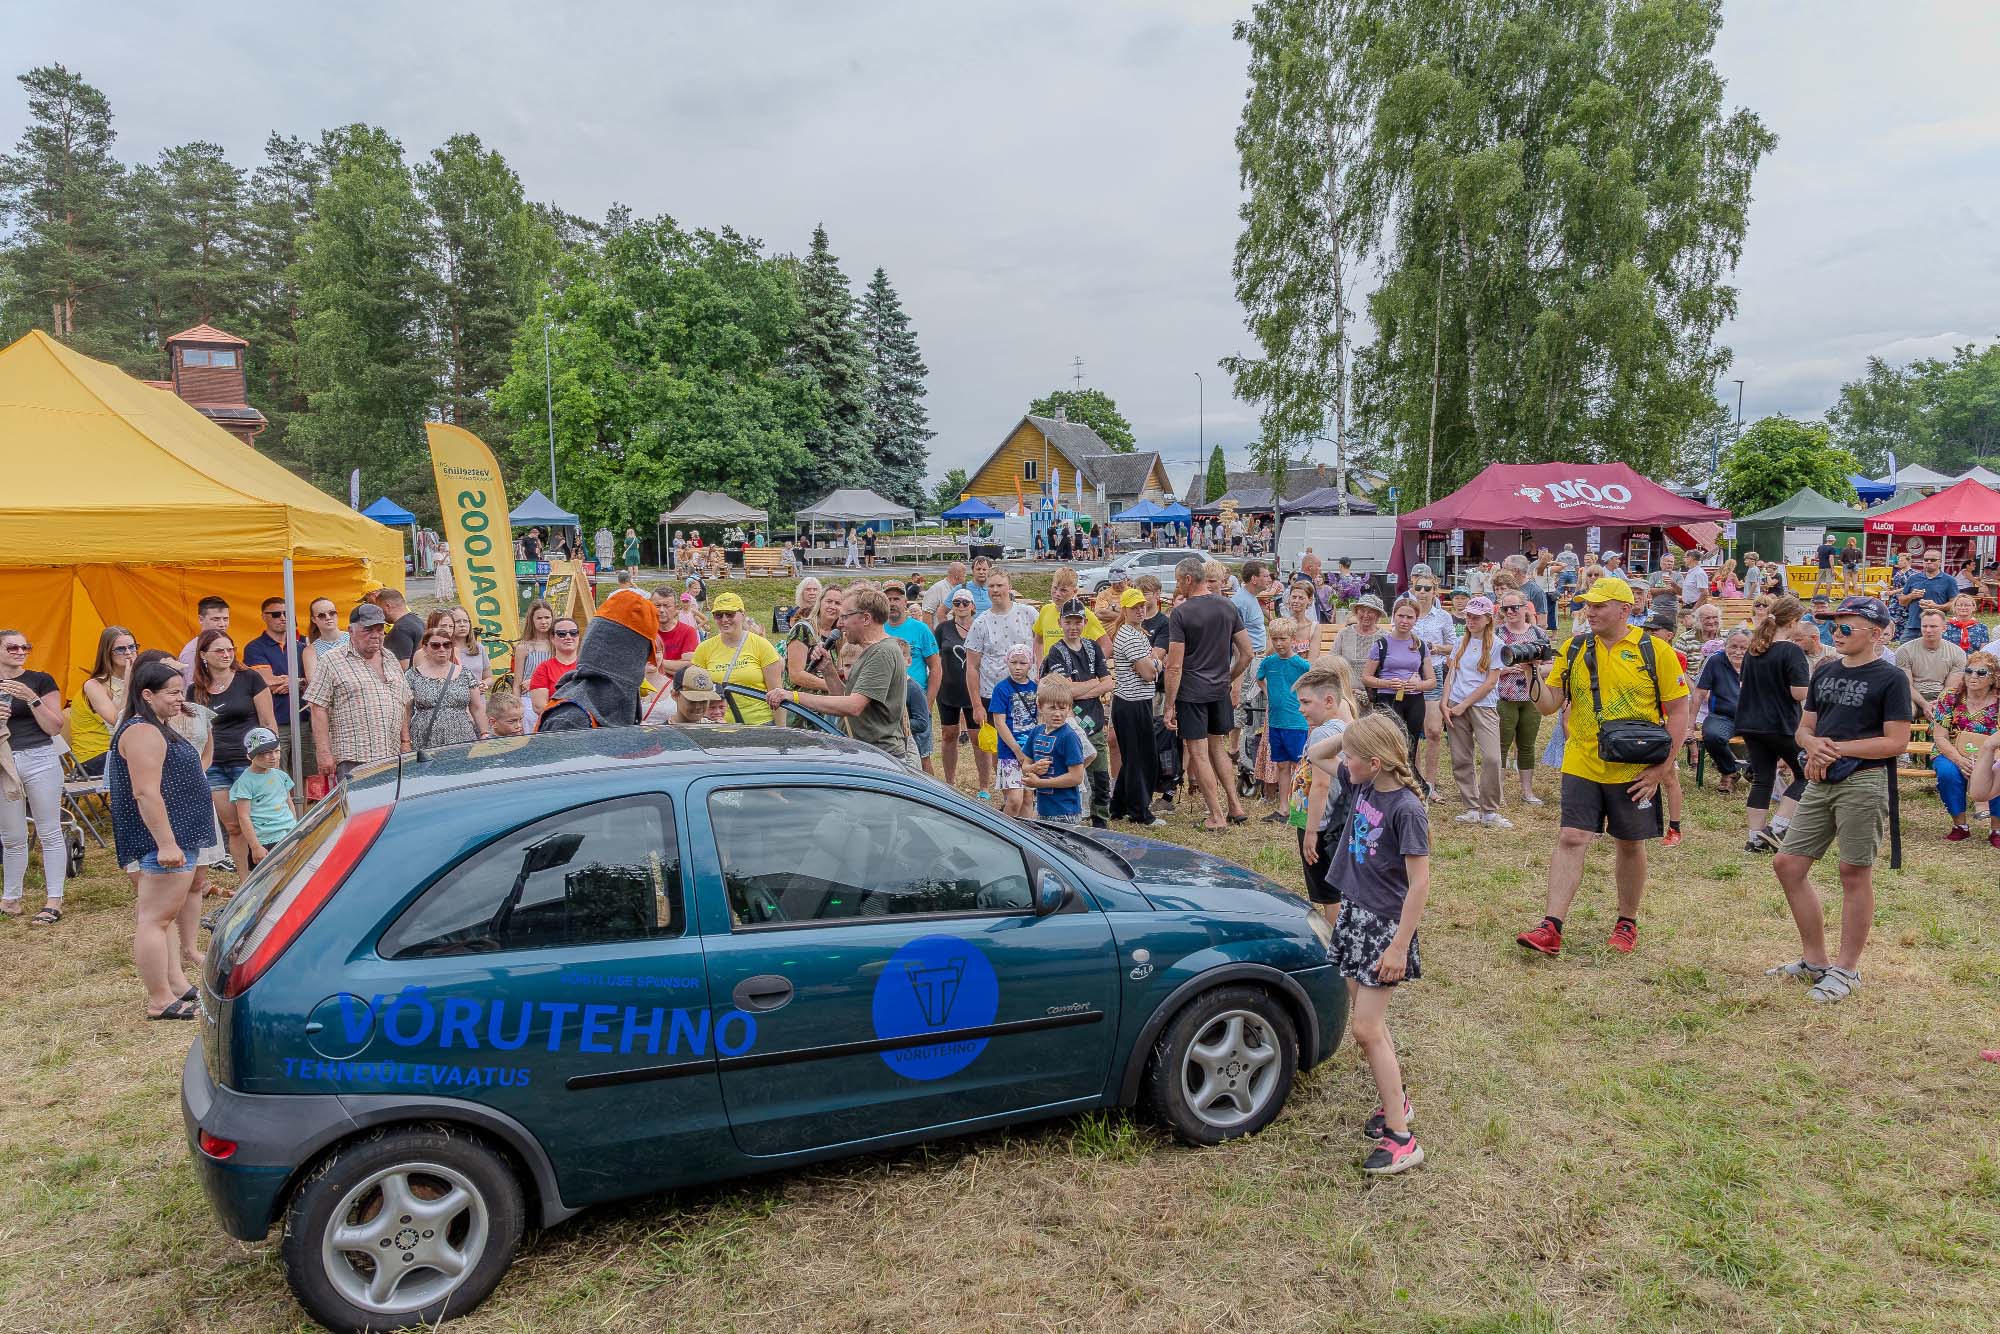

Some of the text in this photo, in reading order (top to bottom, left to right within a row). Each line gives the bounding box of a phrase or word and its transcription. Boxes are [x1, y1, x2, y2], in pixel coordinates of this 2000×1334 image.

[1544, 478, 1632, 503] NÕO
[1816, 689, 1865, 707] JONES
[637, 975, 700, 989] SPONSOR
[338, 985, 758, 1057] VÕRUTEHNO
[283, 1057, 531, 1088] TEHNOÜLEVAATUS
